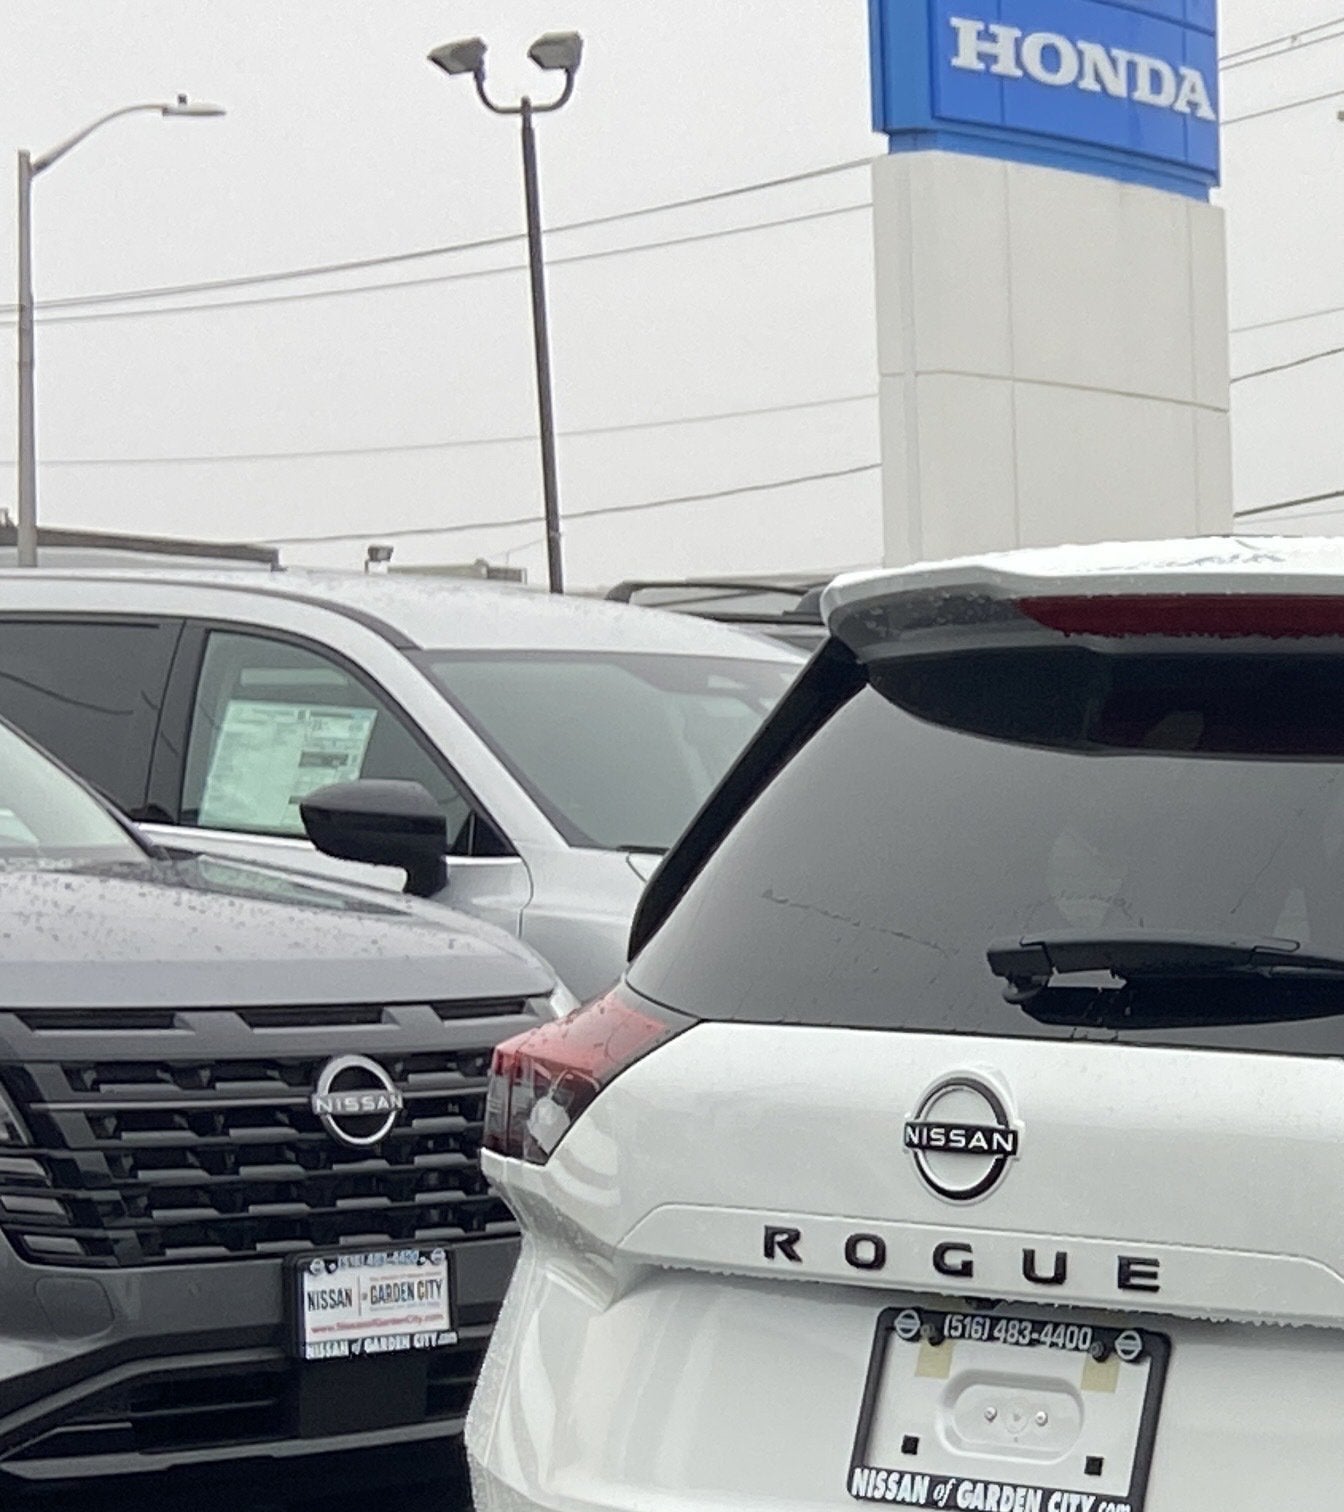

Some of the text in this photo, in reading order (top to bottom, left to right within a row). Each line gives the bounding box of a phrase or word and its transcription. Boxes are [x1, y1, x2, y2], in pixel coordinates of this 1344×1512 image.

[949, 16, 1217, 121] HONDA
[314, 1093, 403, 1114] NISSAN
[904, 1124, 1014, 1152] NISSAN
[762, 1224, 1161, 1293] ROGUE
[306, 1287, 353, 1313] NISSAN
[369, 1280, 415, 1306] GARDEN
[416, 1278, 444, 1300] CITY
[943, 1314, 1093, 1351] (516) 483-4400
[851, 1467, 931, 1505] NISSAN
[932, 1479, 955, 1508] of
